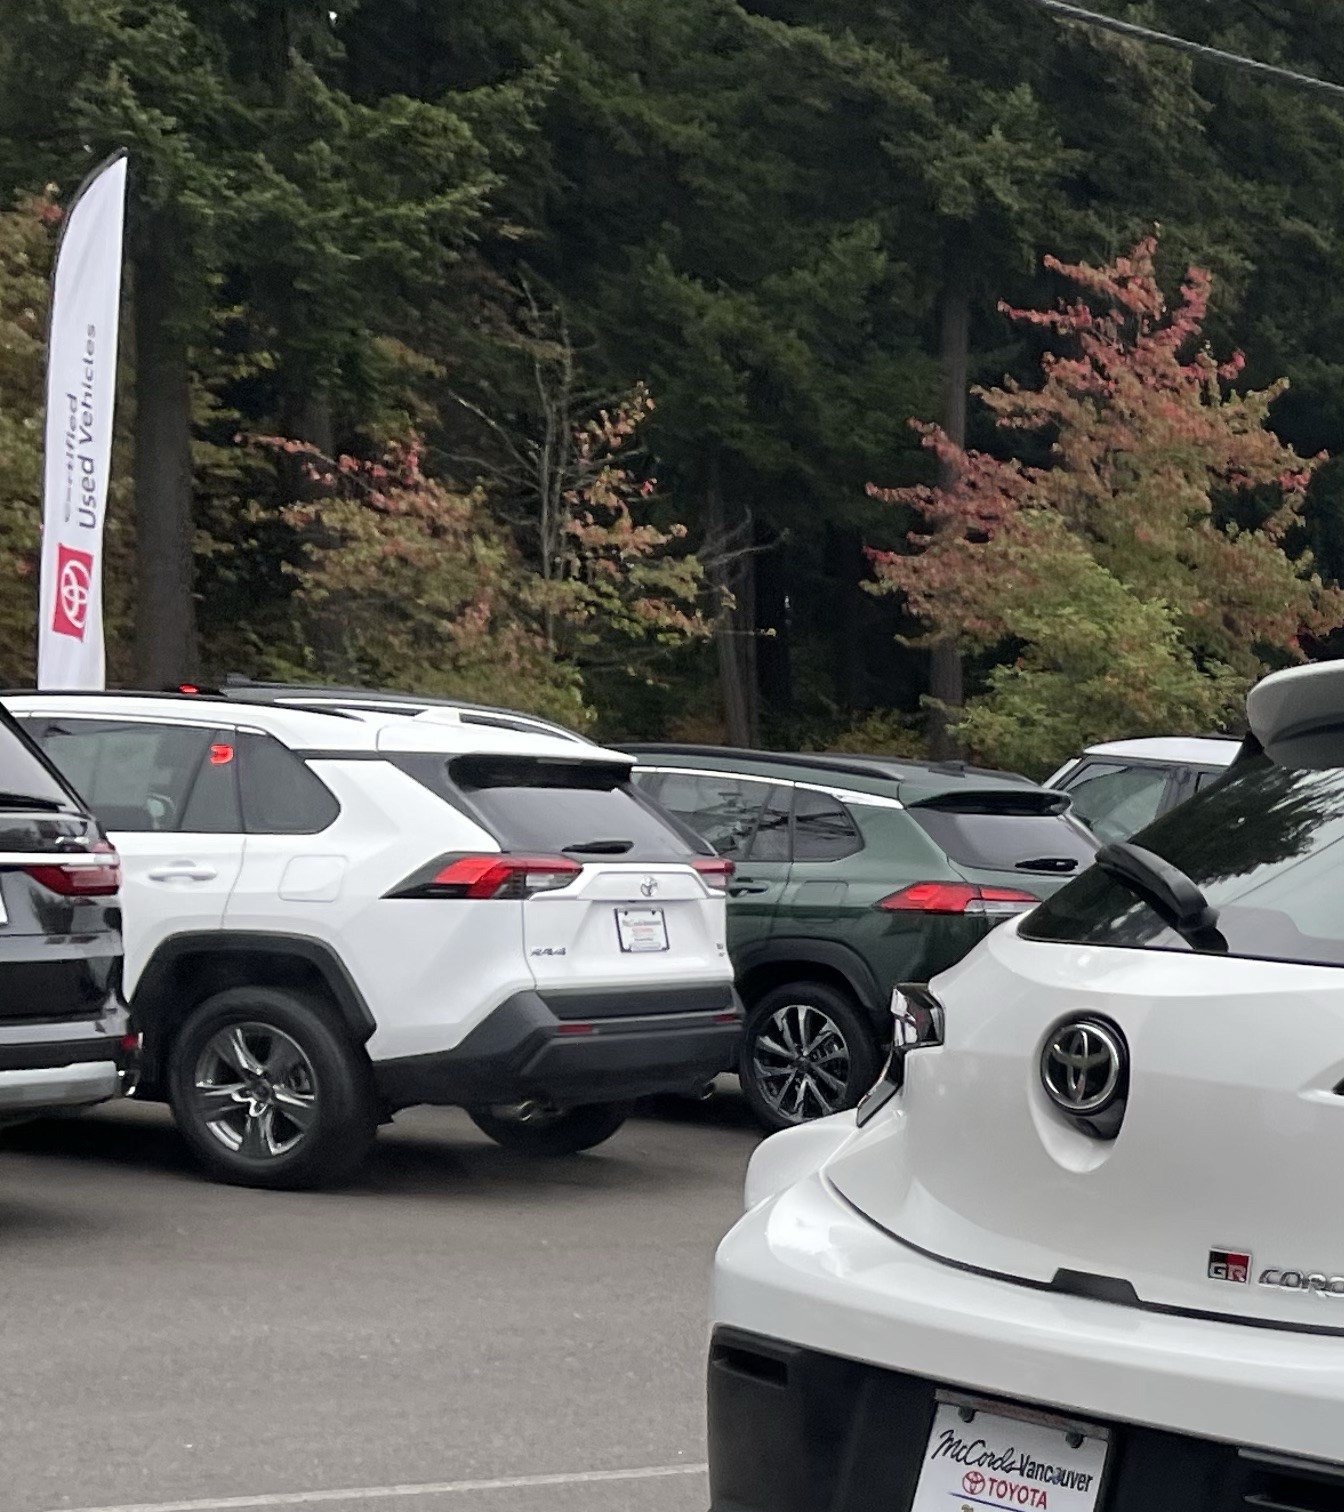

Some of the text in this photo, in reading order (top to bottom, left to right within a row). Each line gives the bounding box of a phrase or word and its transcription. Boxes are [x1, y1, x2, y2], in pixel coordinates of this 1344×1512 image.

[77, 323, 97, 530] Used Vehicles
[1209, 1262, 1248, 1283] GR
[1019, 1453, 1094, 1493] Vancouver
[987, 1477, 1048, 1510] TOYOTA
